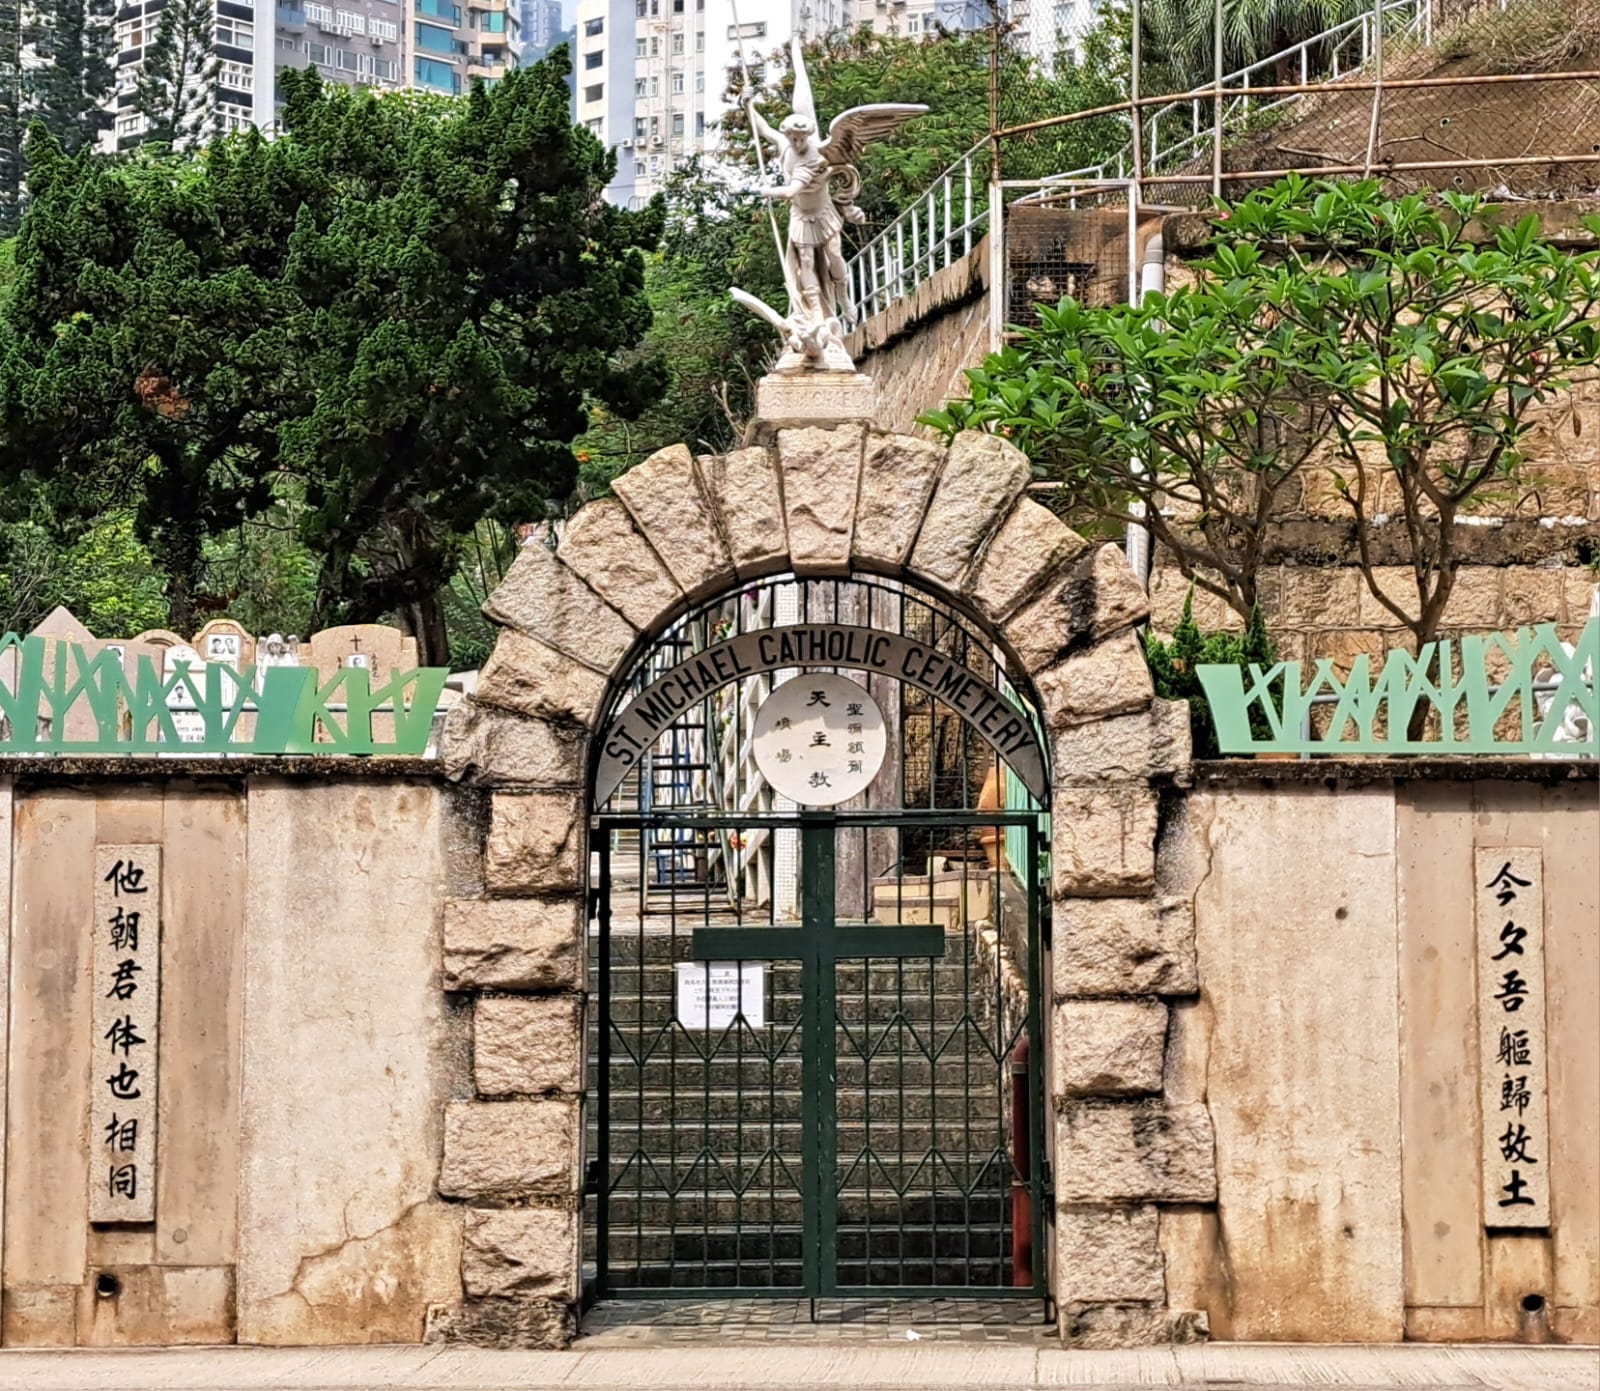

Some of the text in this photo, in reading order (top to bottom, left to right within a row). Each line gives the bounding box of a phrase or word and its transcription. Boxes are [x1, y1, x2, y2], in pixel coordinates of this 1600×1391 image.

[605, 630, 1035, 765] ST. MICHAEL CATHOLIC CEMETERY
[775, 716, 792, 763] 墳場
[806, 690, 832, 788] 天主教
[104, 859, 148, 1200] 他朝君体也相同
[1485, 861, 1538, 1207] 今夕吾軀歸故土
